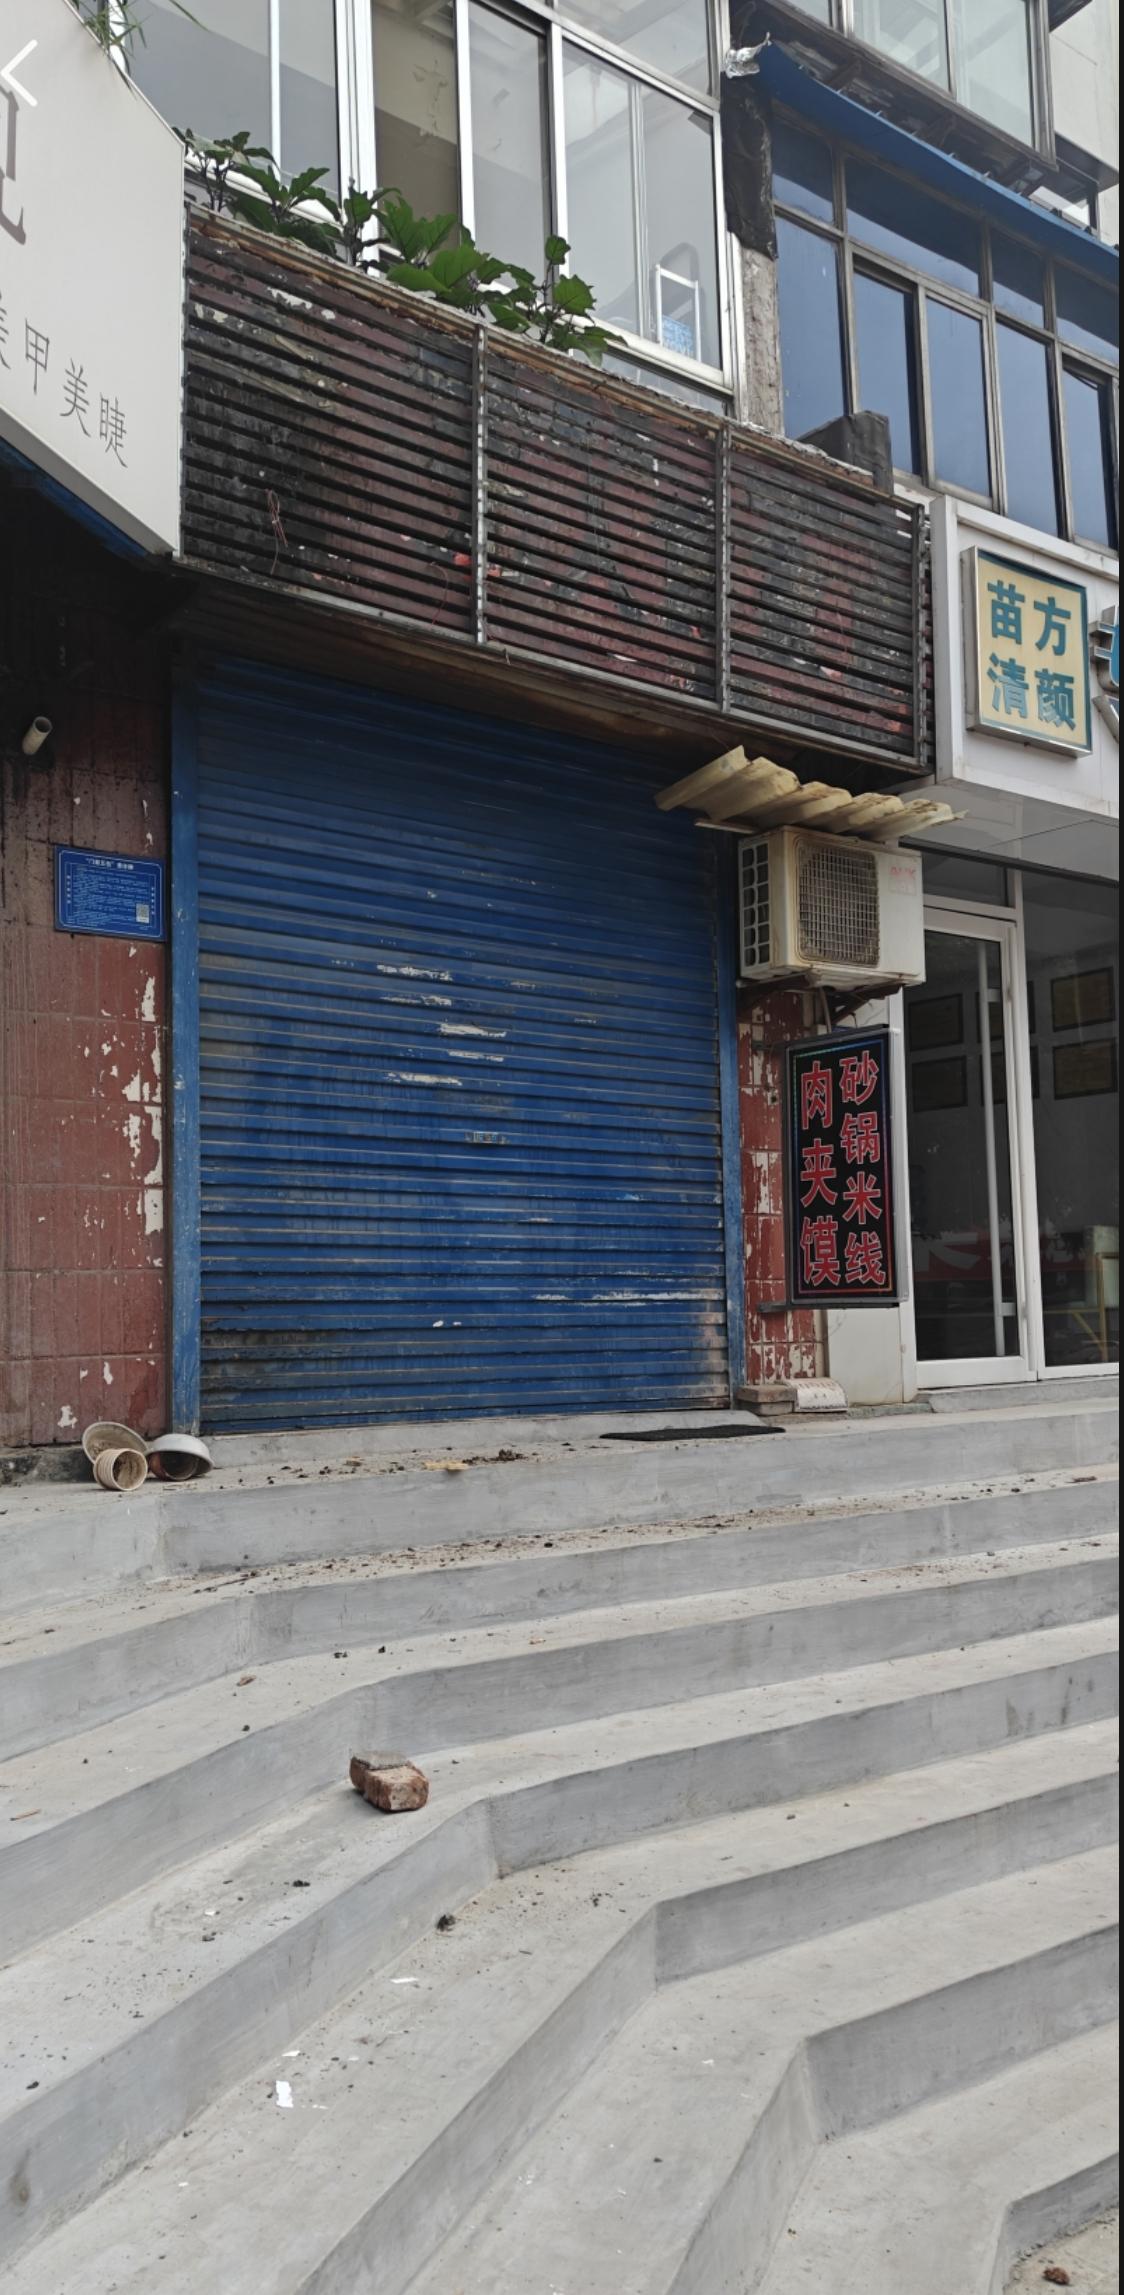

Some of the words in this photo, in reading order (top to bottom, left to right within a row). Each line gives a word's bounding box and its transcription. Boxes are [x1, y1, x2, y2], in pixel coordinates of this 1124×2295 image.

[986, 651, 1076, 731] 清颜
[987, 579, 1072, 656] 苗方
[799, 1059, 842, 1288] 肉夹馍
[838, 1049, 886, 1286] 砂锅米线
